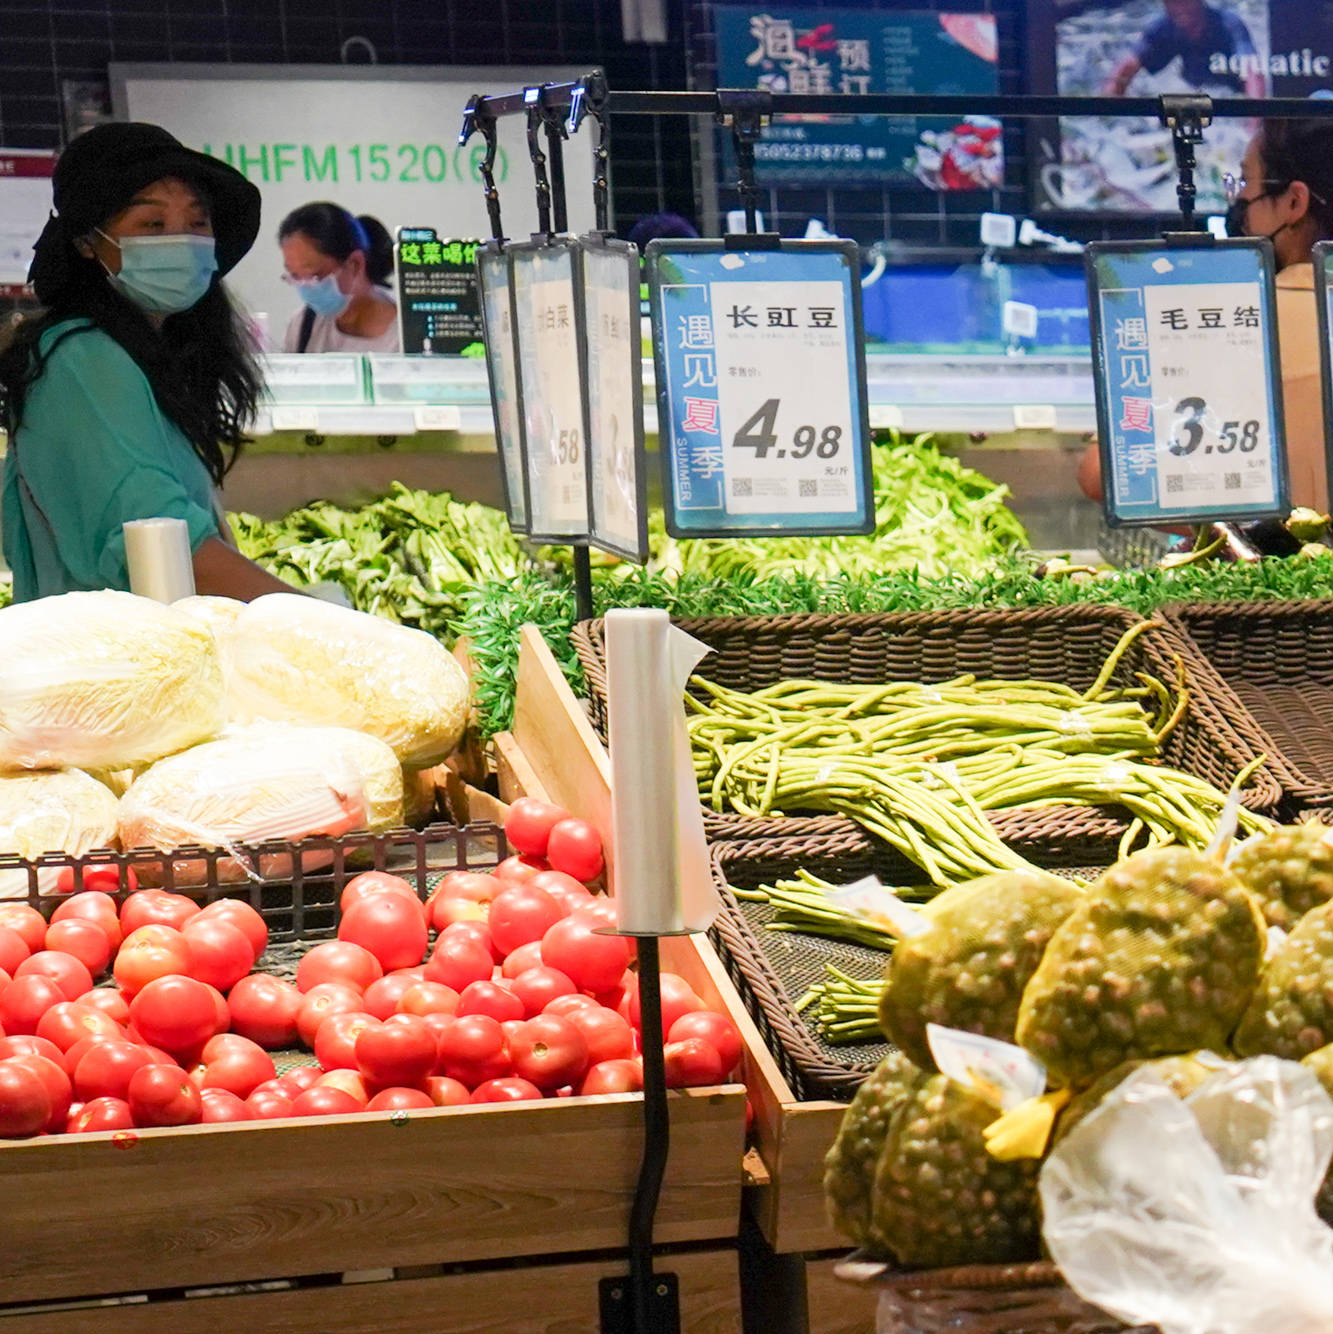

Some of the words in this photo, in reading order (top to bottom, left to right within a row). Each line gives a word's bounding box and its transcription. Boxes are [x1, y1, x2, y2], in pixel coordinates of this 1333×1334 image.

[1209, 48, 1329, 80] aquatic
[726, 304, 838, 329] 长豇豆
[1160, 306, 1261, 330] 毛豆结
[732, 398, 842, 459] 4.98
[1168, 396, 1261, 457] 3.58
[677, 437, 692, 501] SUMMER
[1115, 435, 1130, 497] SUMMER
